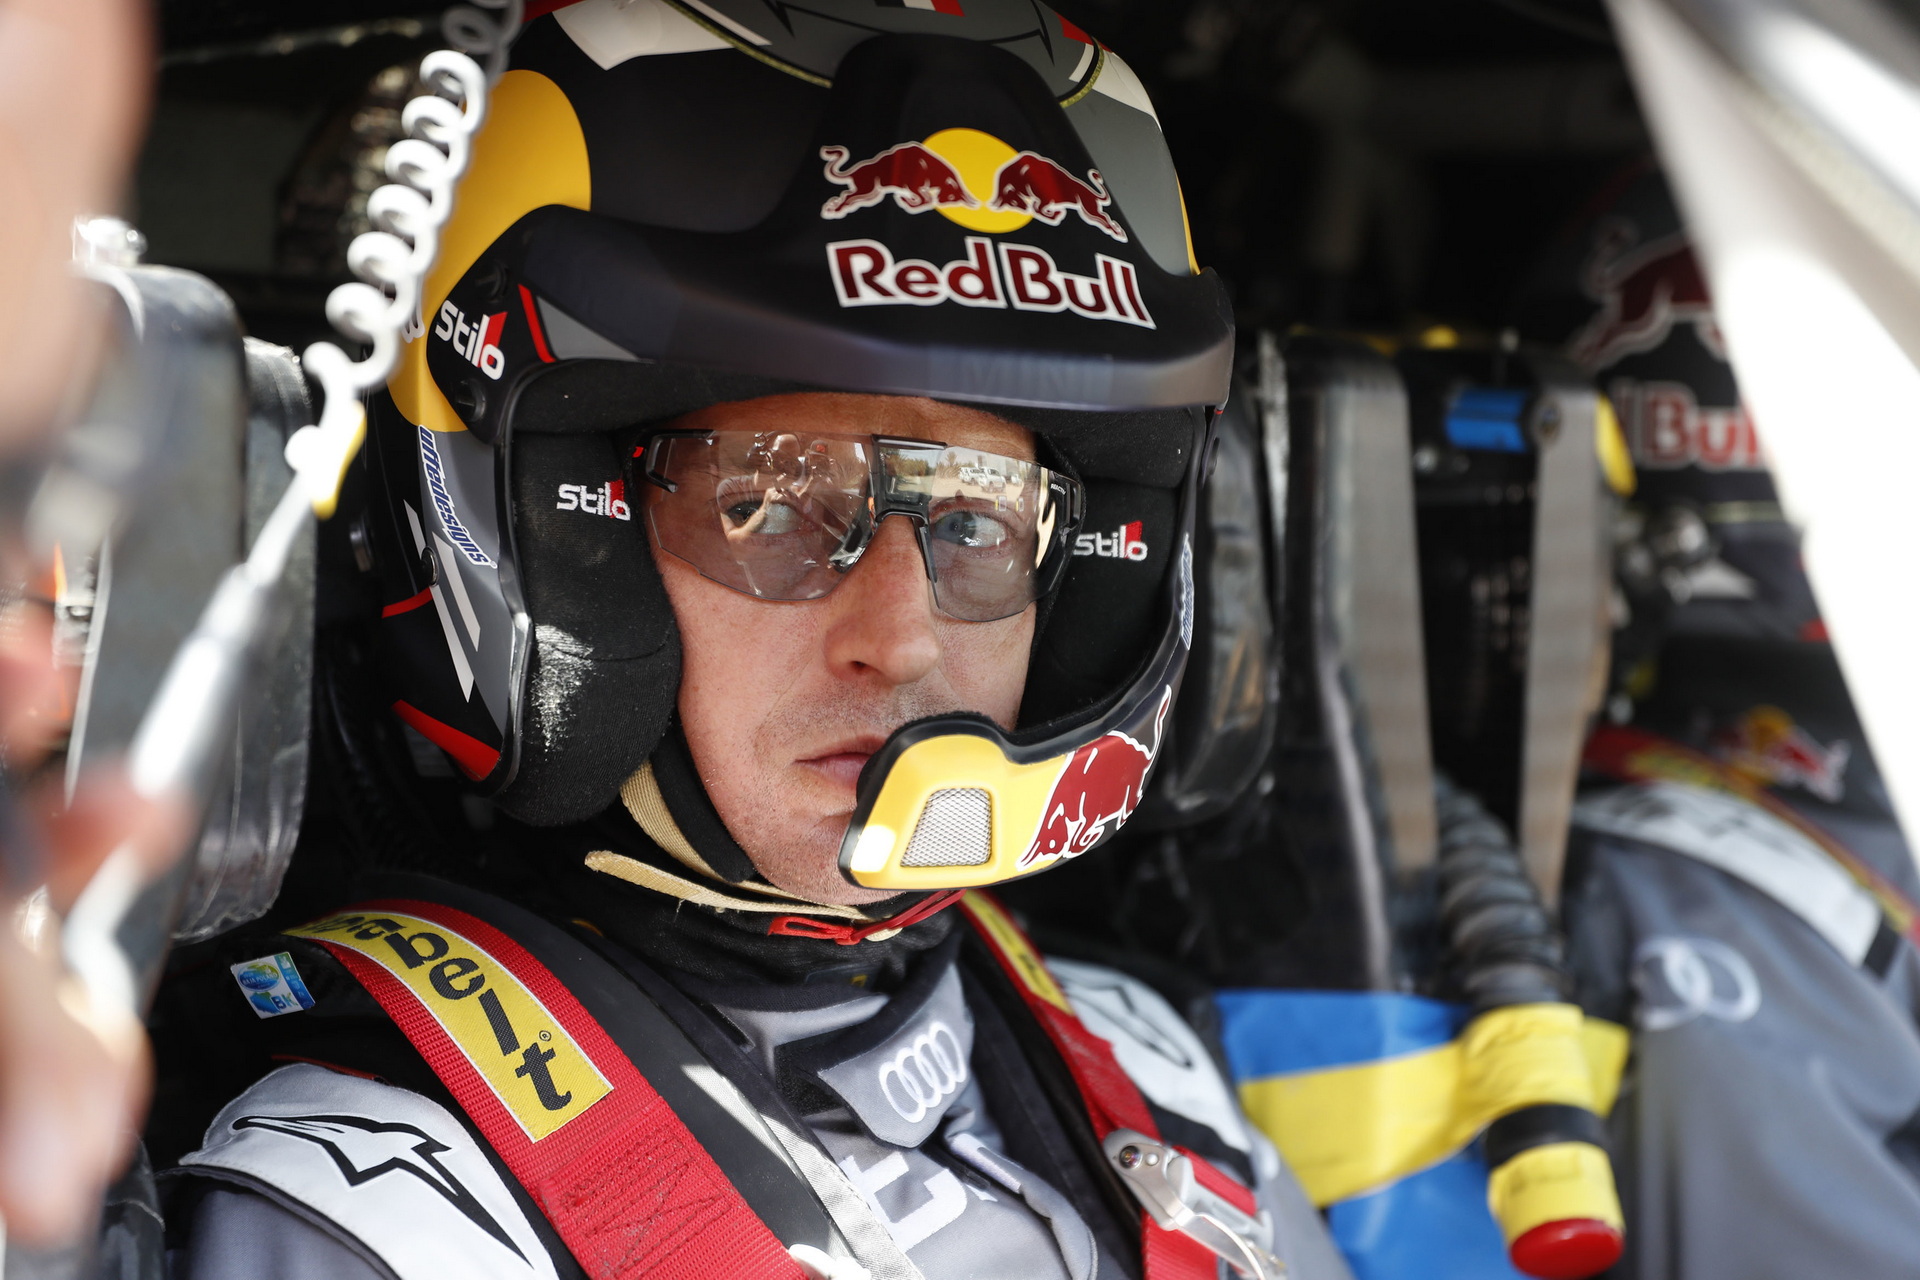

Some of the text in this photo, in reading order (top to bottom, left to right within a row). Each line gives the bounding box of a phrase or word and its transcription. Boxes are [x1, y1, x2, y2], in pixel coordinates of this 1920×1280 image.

[829, 237, 1154, 327] Red Bull
[419, 425, 492, 565] uffedesigns
[271, 992, 298, 1009] BK
